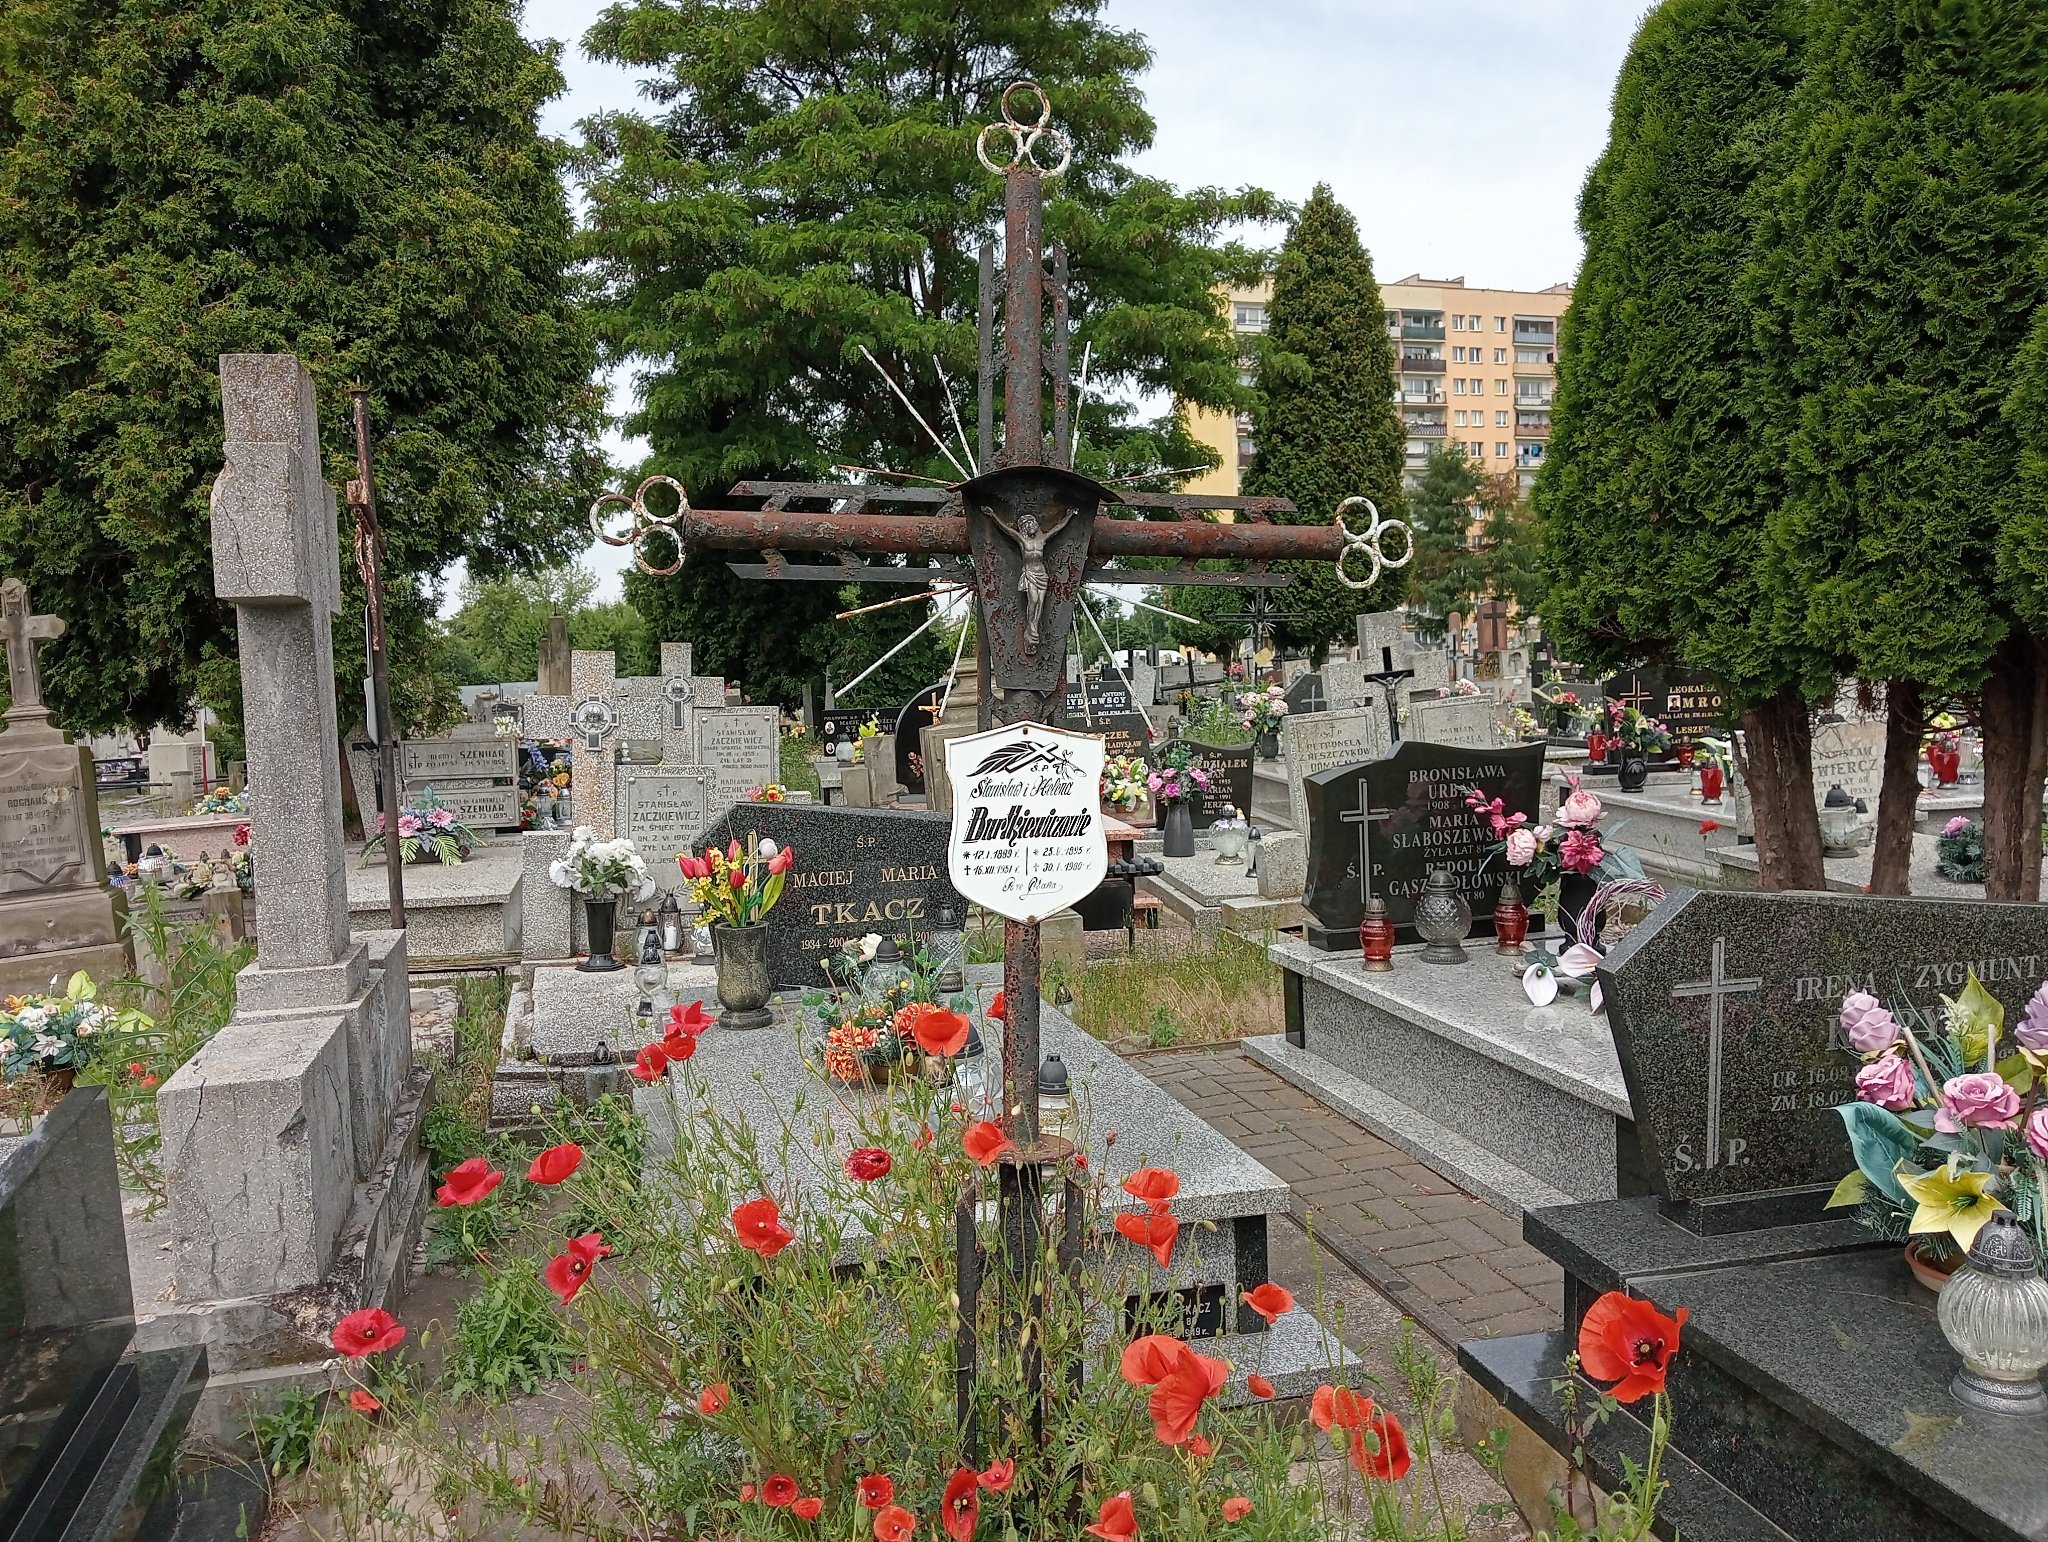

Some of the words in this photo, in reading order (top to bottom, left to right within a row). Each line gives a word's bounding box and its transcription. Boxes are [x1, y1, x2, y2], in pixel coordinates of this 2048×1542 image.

[1409, 765, 1506, 783] BRONISŁAWA
[1023, 784, 1030, 797] i
[1030, 776, 1074, 797] Helena
[460, 804, 505, 813] SZENUAR
[637, 800, 694, 809] STANISŁAW
[1427, 800, 1450, 811] 1908
[962, 805, 1092, 847] Bartkiewiczowie
[1429, 813, 1479, 829] MARIA
[792, 870, 854, 888] MACIEJ
[881, 865, 939, 883] MARIA
[1473, 890, 1485, 900] 80
[811, 897, 925, 925] TKACZ
[801, 939, 822, 950] 1934
[1793, 972, 1878, 1002] IRENA
[1914, 955, 2042, 989] ZYGMUNT
